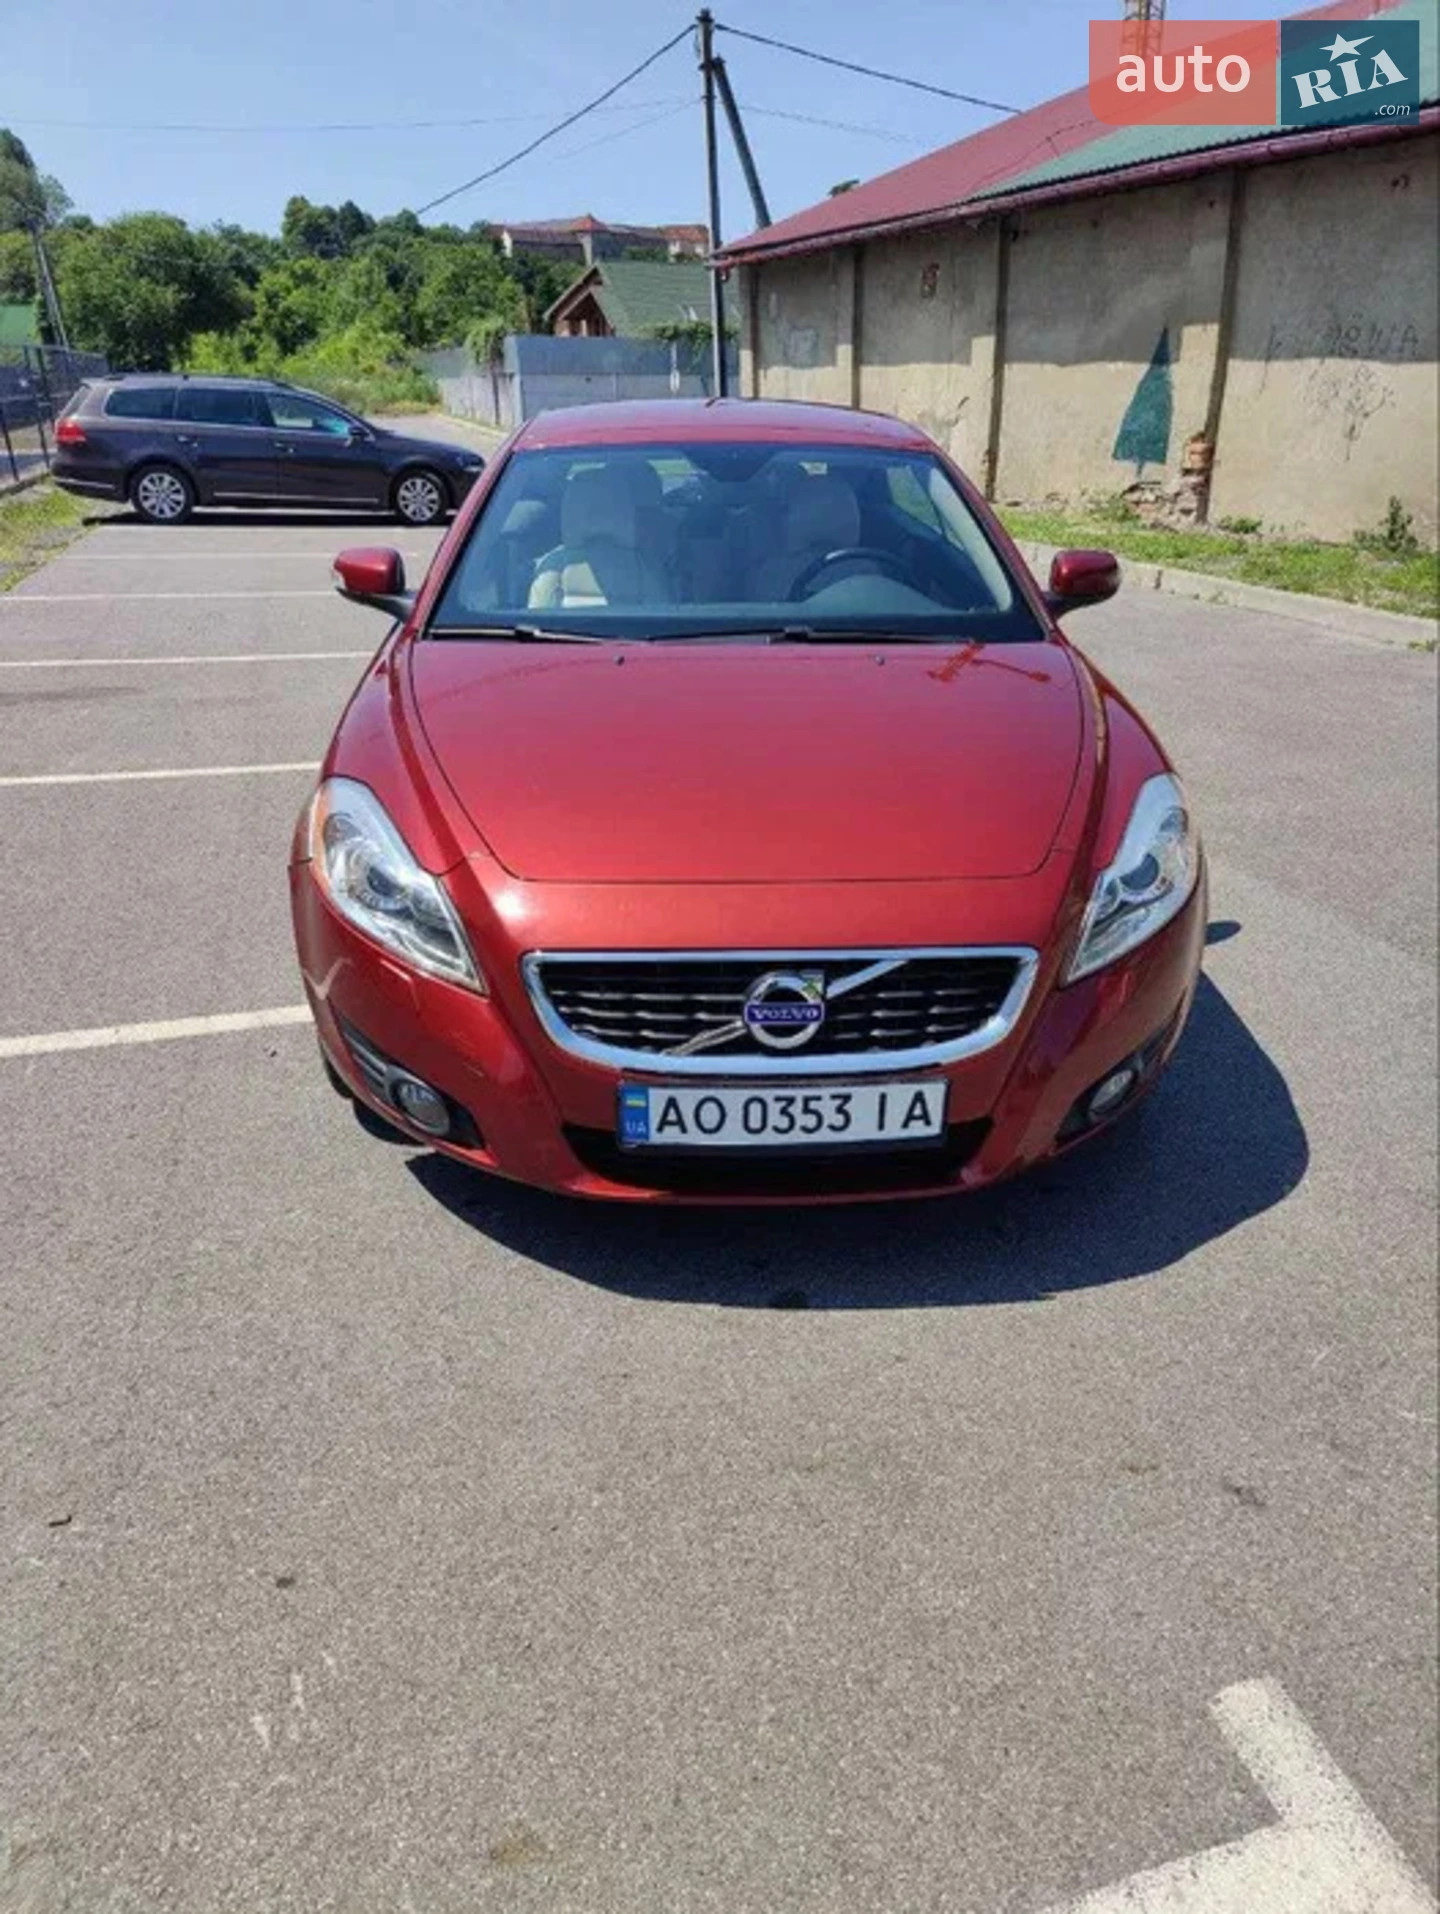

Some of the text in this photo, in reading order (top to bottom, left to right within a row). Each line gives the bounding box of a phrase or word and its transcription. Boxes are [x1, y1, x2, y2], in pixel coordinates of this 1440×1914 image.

[752, 1007, 819, 1020] VOLVO
[656, 1090, 932, 1135] AO 0353 IA
[625, 1120, 647, 1134] UA
